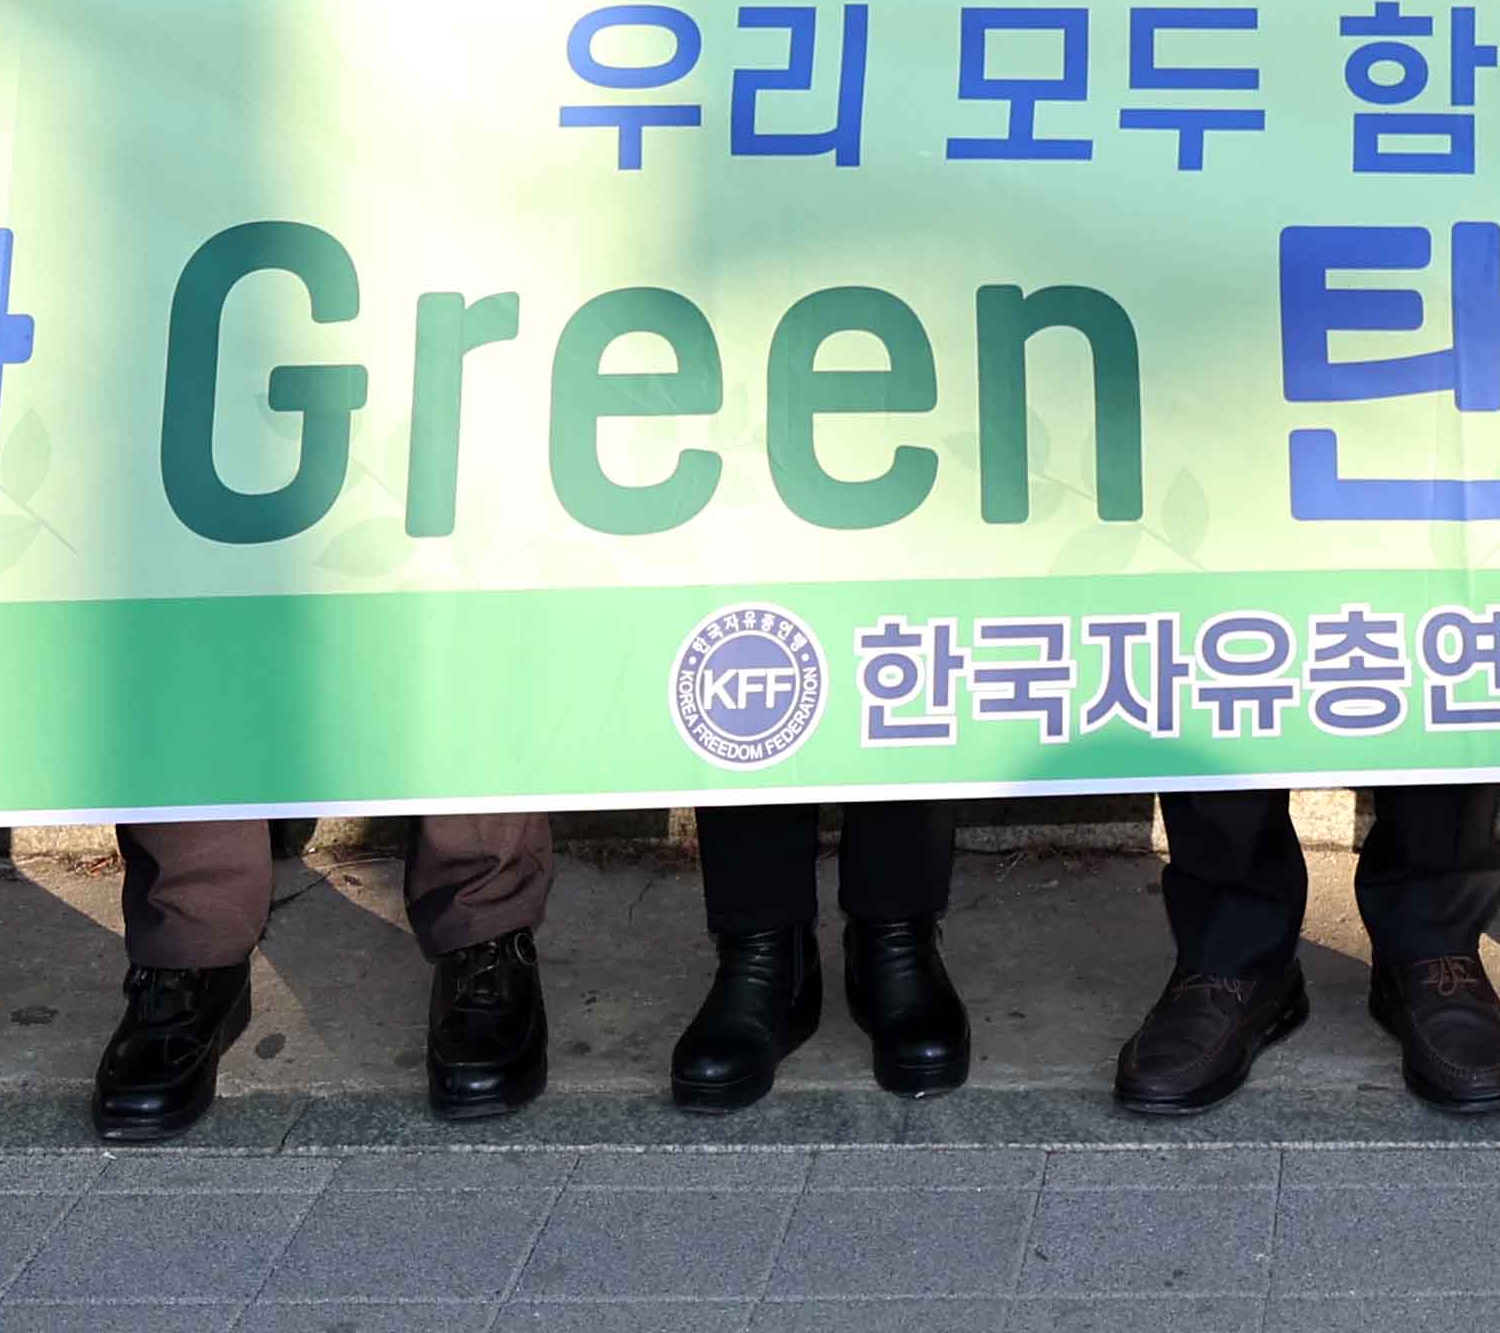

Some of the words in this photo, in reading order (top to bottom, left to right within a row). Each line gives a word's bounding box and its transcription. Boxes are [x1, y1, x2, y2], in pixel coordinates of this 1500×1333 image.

[558, 2, 870, 172] 우리
[945, 6, 1267, 173] 모두
[160, 219, 1145, 546] Green
[678, 669, 699, 728] KOREA
[693, 722, 764, 761] FREEDOM
[765, 666, 819, 755] FEDERATION
[702, 667, 795, 710] KFF
